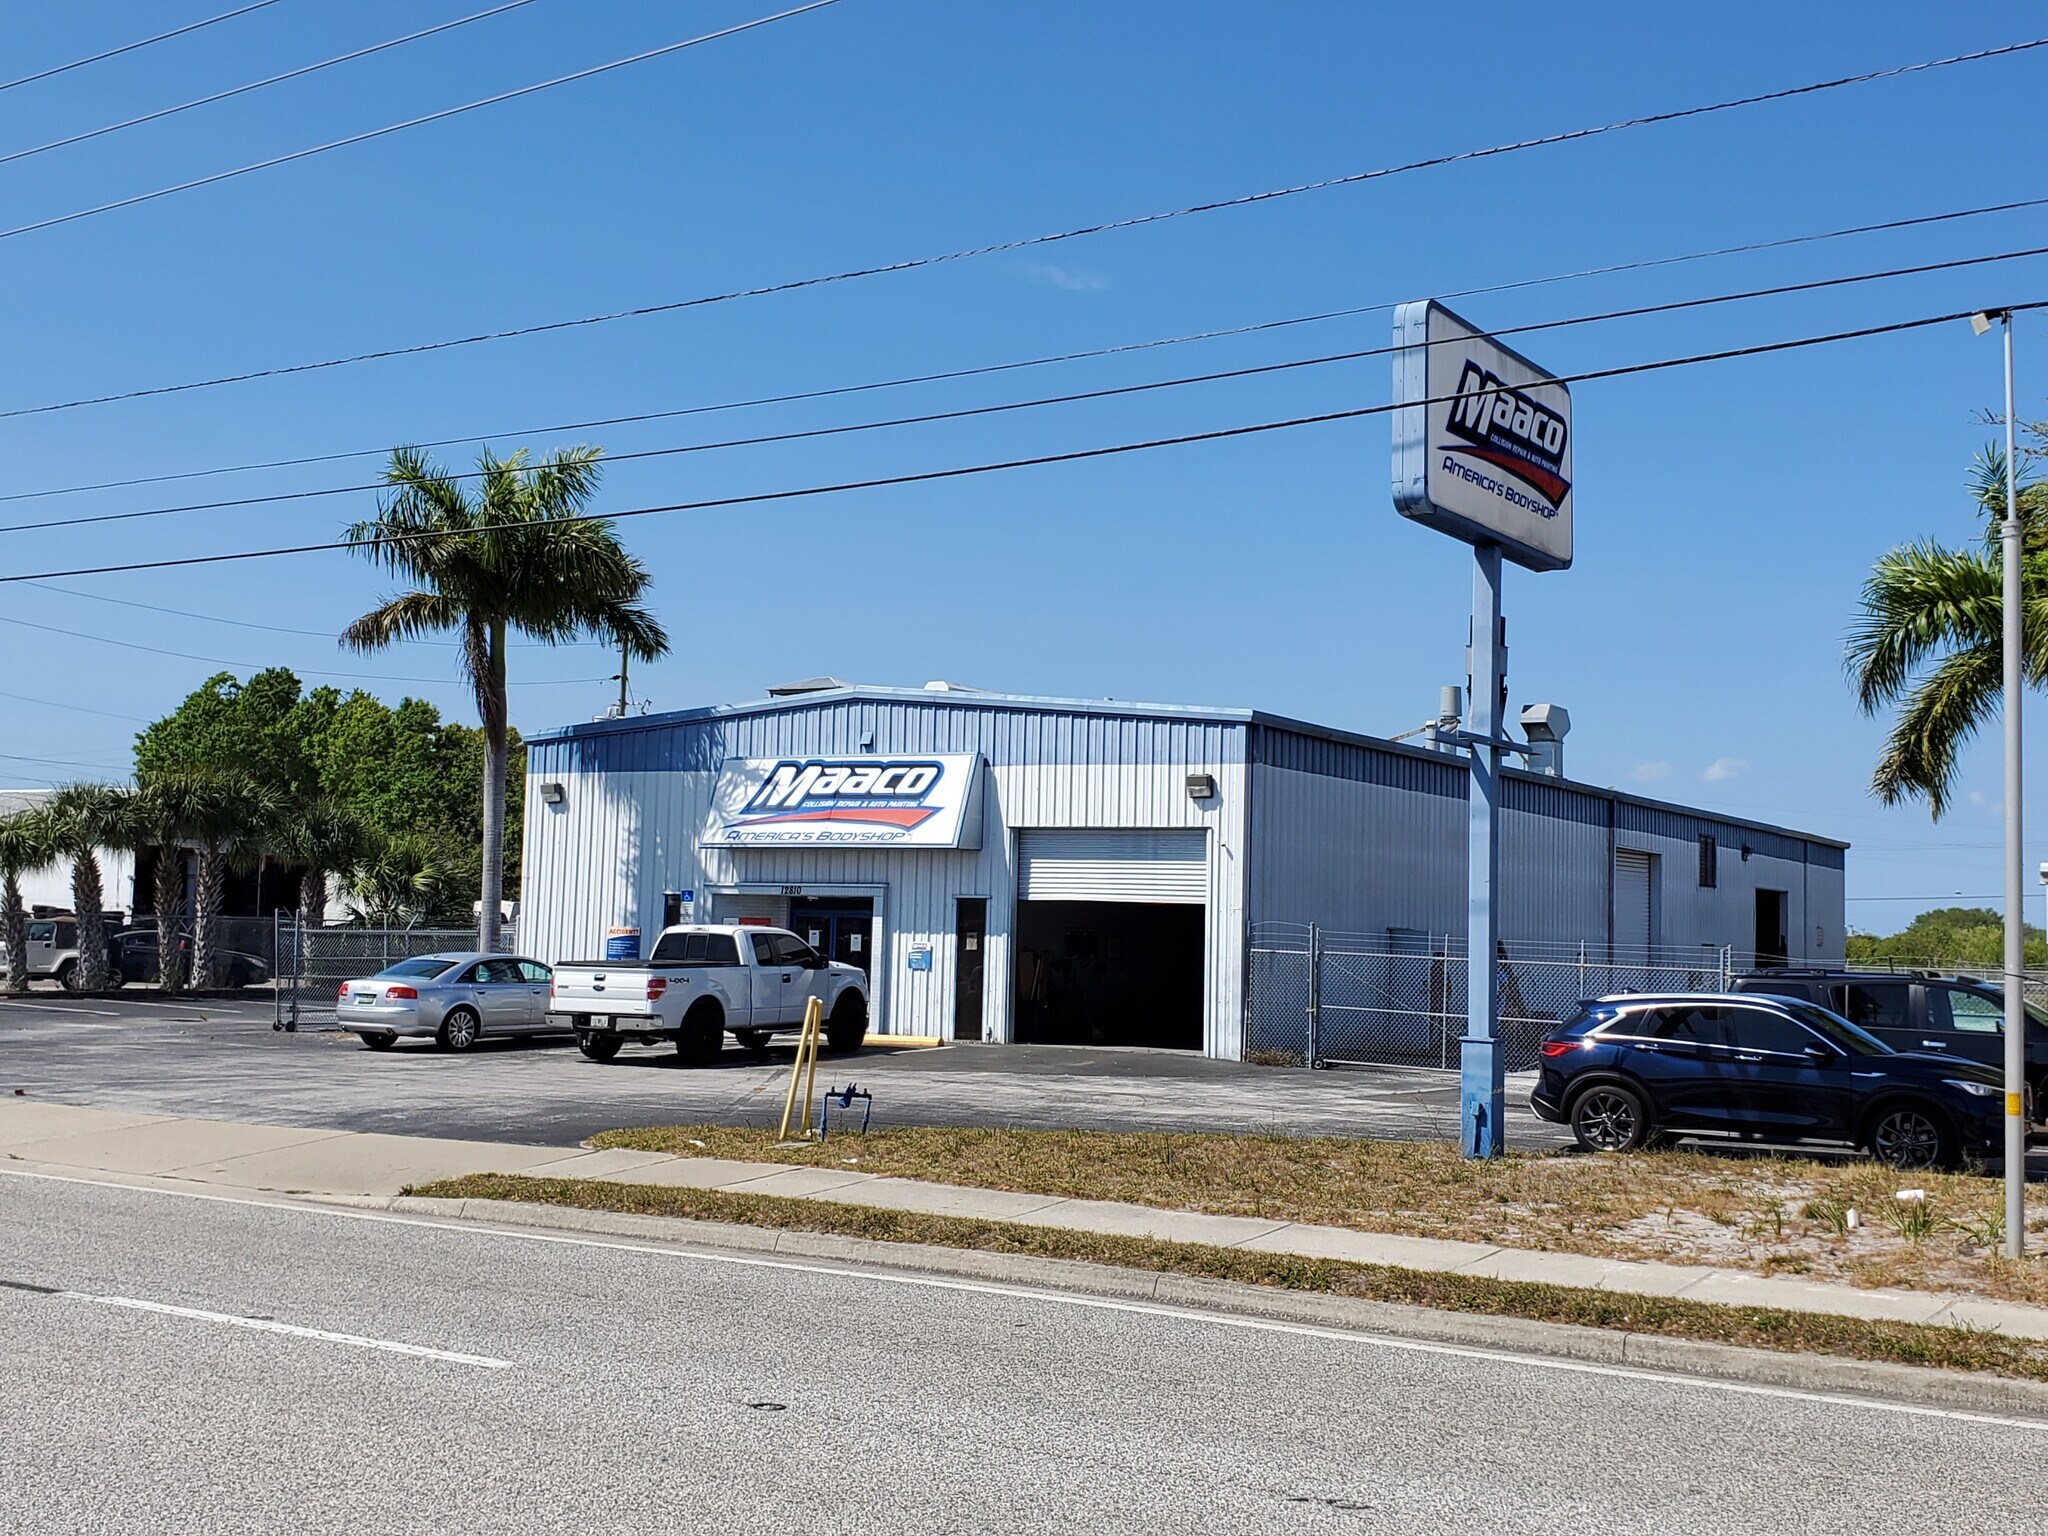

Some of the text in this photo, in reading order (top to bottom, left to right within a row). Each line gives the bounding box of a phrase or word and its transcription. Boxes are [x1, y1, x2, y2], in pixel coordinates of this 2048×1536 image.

[1490, 433, 1512, 450] COLLISION
[1512, 444, 1527, 458] REPAIR
[1531, 454, 1542, 466] AUTO
[1541, 459, 1559, 474] PAINTING
[1442, 456, 1556, 520] AMERICA'S BODYSHOP
[802, 800, 836, 808] COLLISION
[886, 800, 919, 808] PAINTING
[724, 831, 905, 841] AMERICA'S BODYSHOP
[780, 885, 802, 895] 12810
